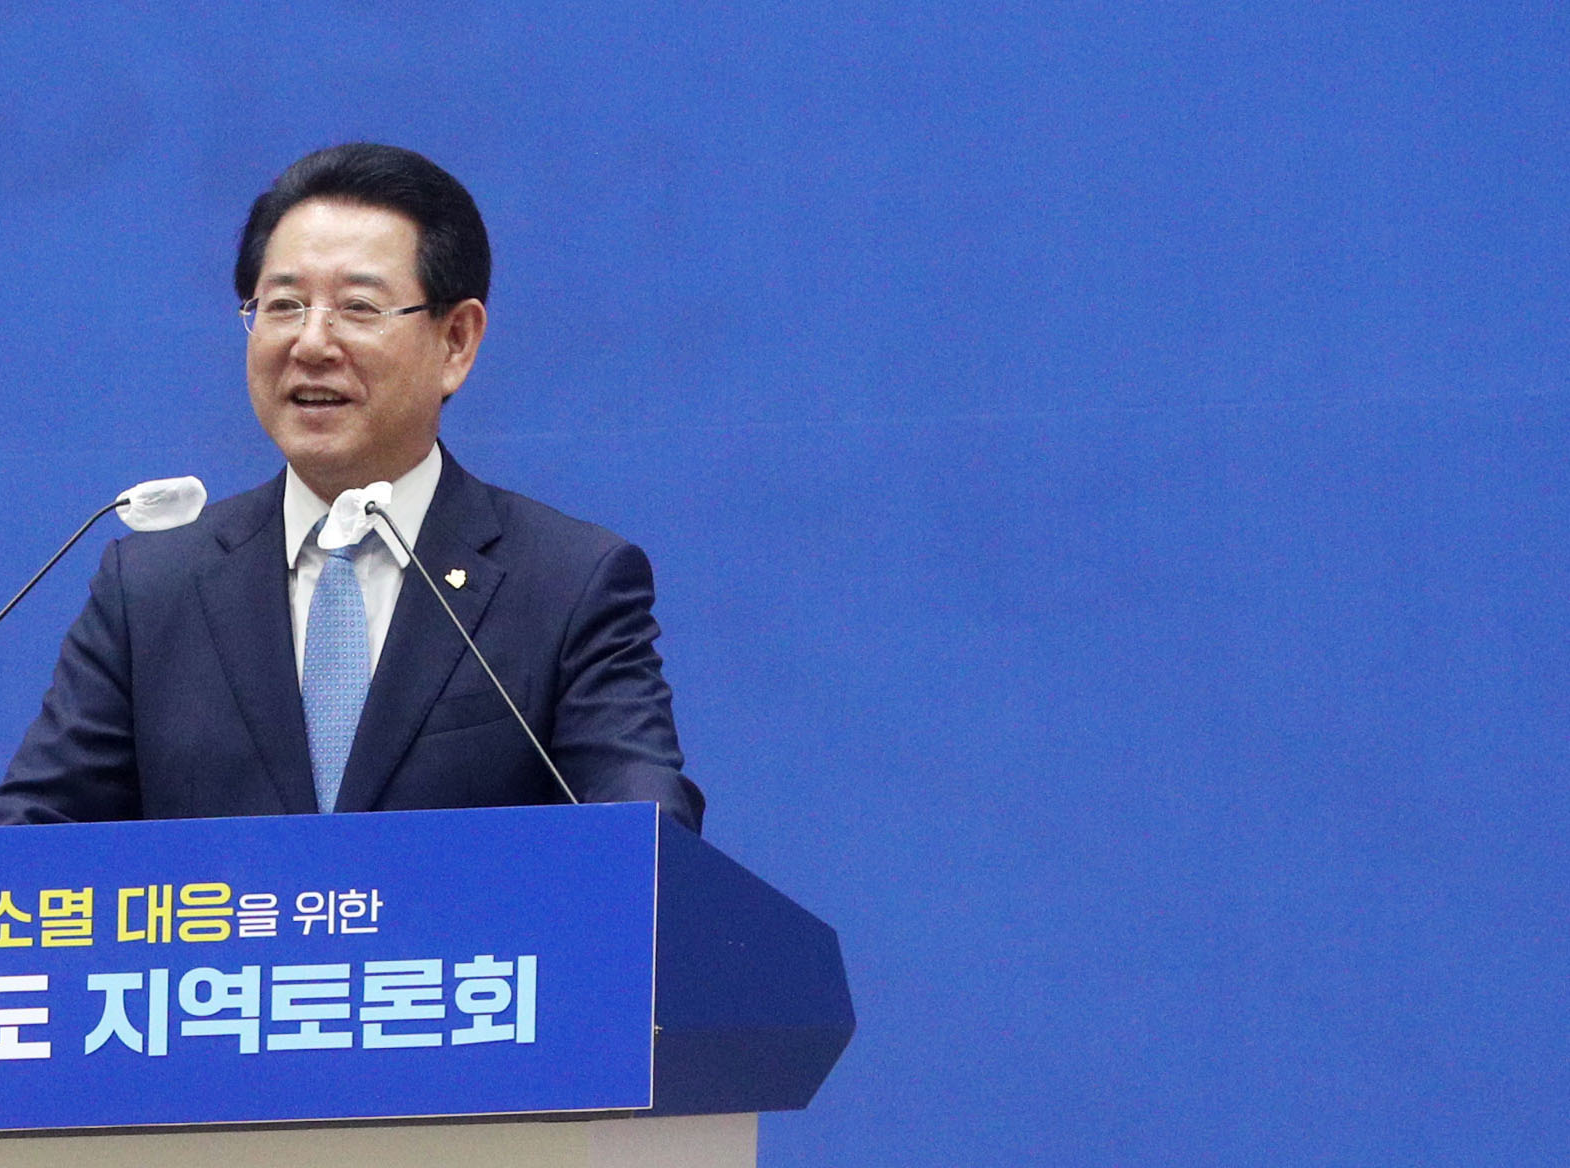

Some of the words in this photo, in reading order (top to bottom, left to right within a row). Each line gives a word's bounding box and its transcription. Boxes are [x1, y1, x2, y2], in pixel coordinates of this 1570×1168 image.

[116, 882, 280, 944] 대응을
[292, 888, 384, 936] 위한
[84, 955, 538, 1059] 지역토론회
